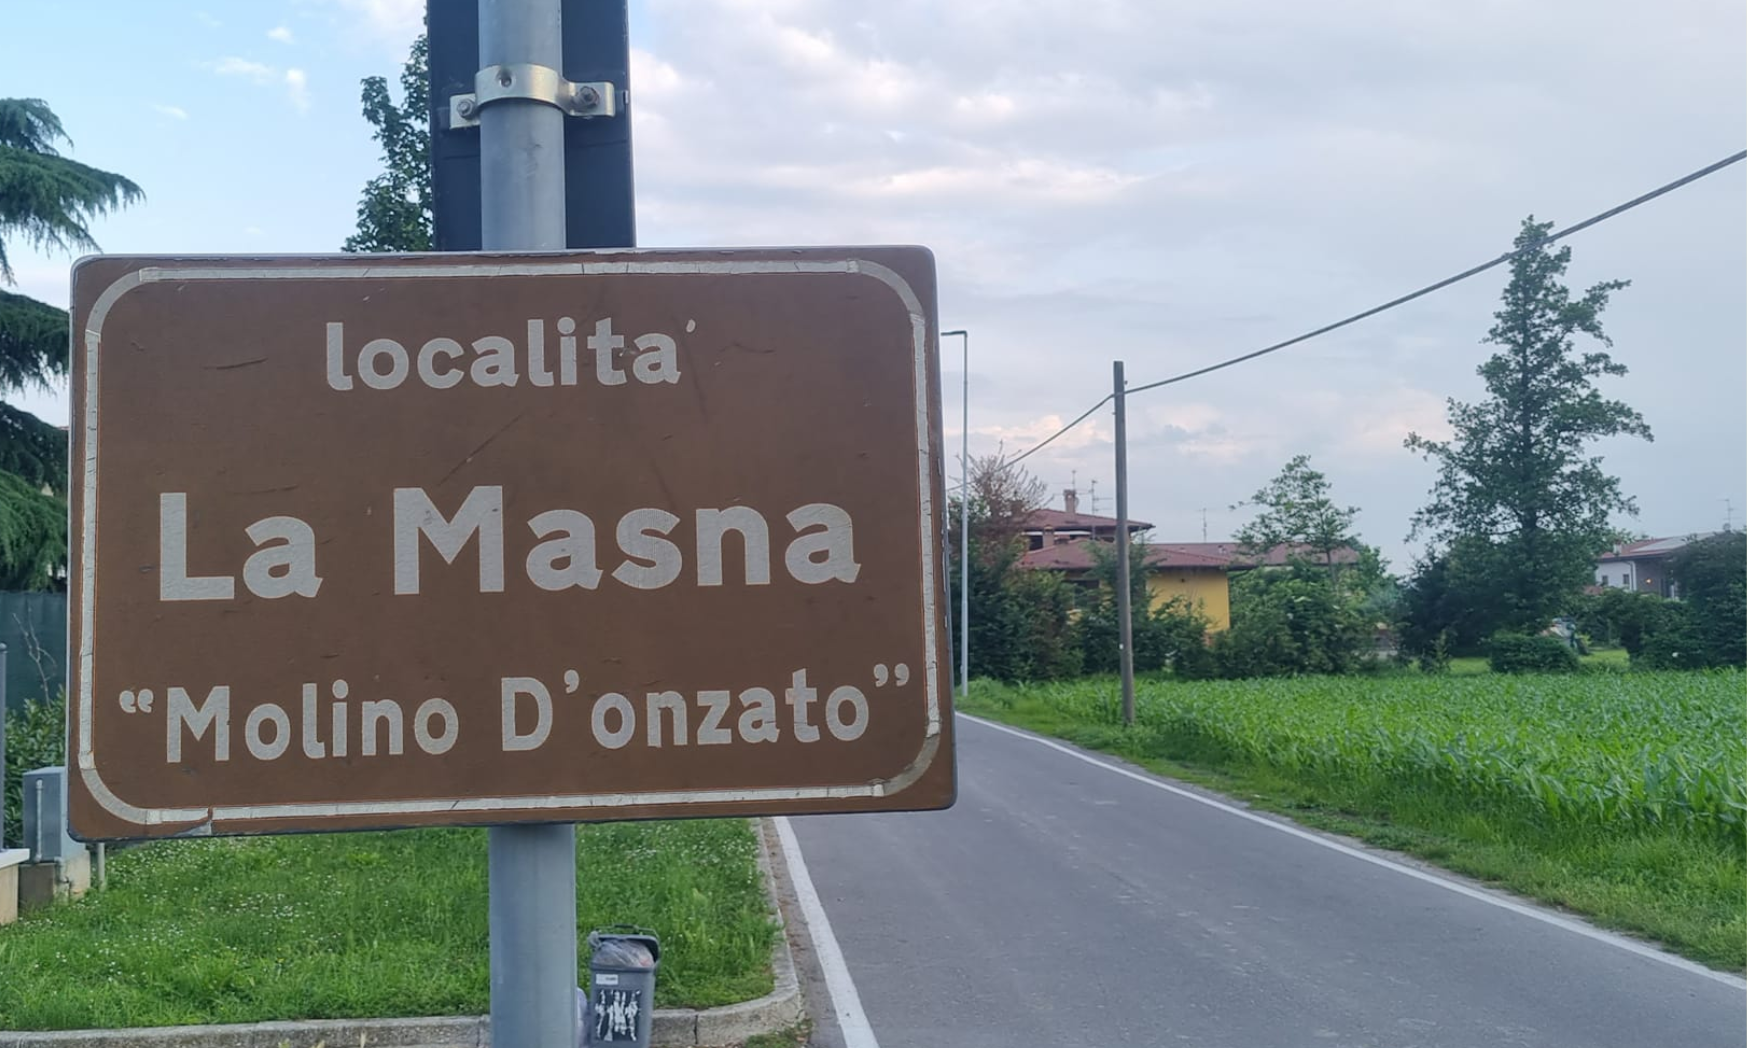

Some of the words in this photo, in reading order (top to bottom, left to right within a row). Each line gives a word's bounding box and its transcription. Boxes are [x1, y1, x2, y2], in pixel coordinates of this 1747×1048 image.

[159, 492, 324, 602] La
[393, 485, 862, 595] Masna
[118, 679, 459, 763] “Molino
